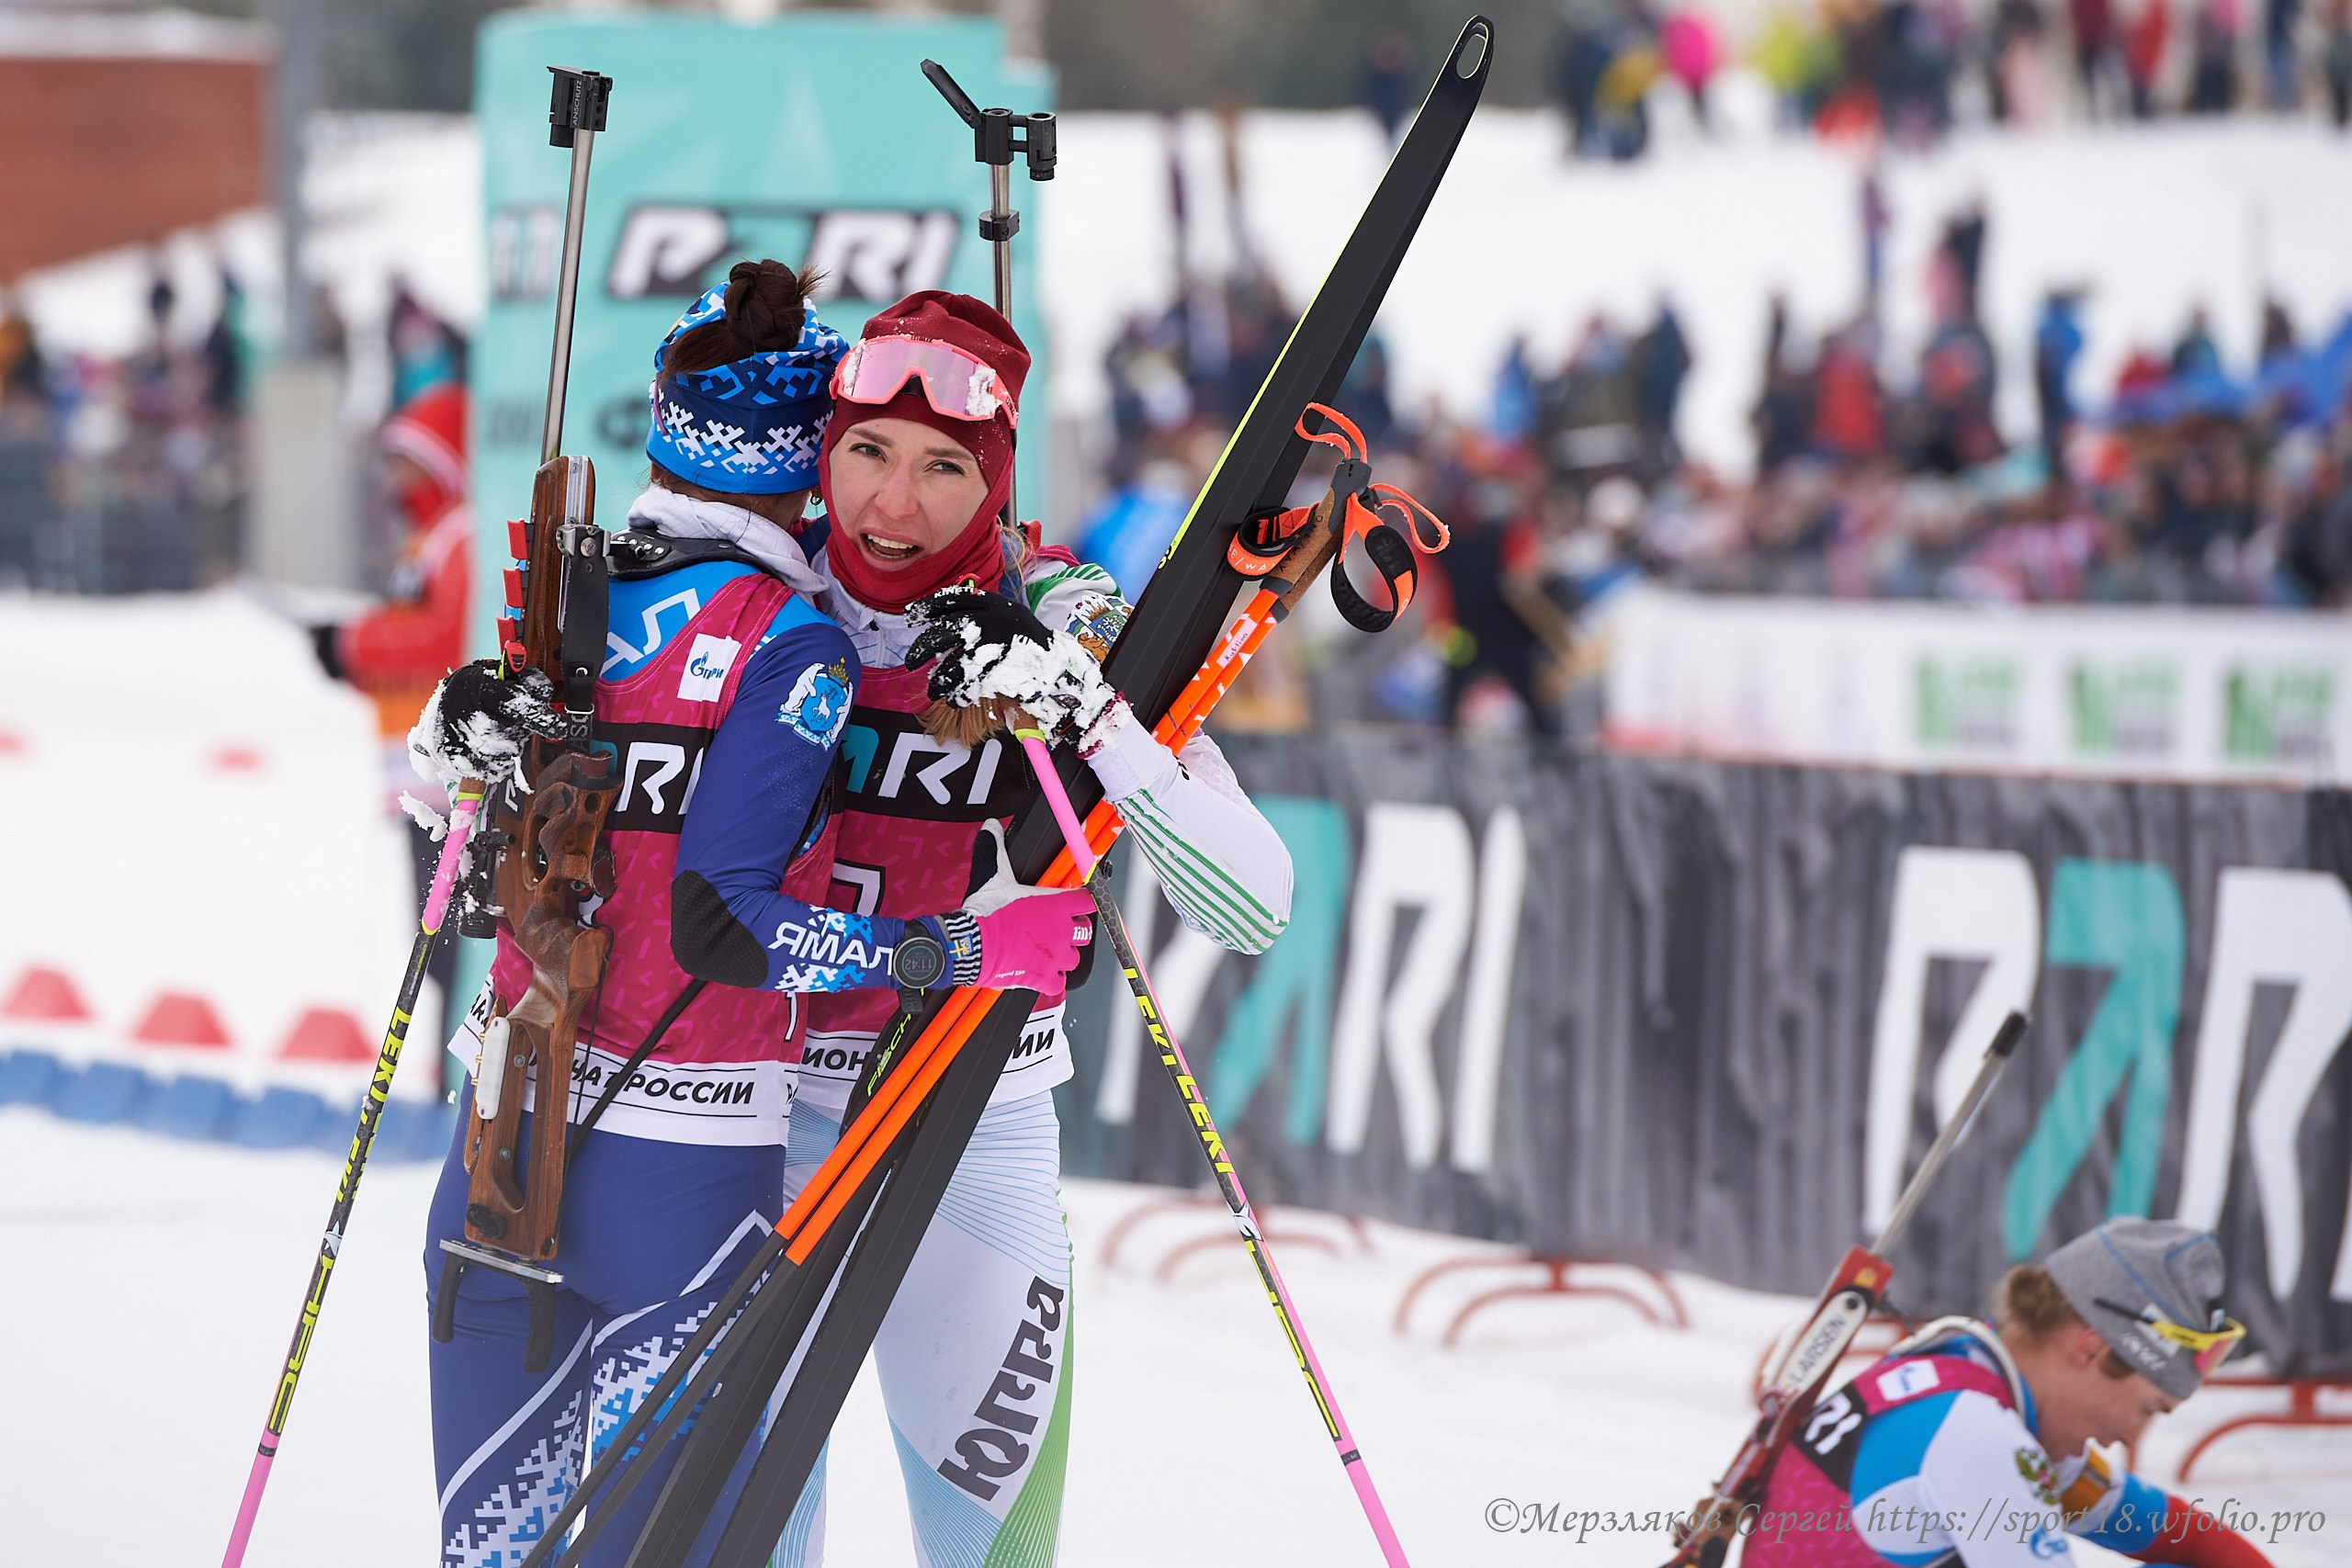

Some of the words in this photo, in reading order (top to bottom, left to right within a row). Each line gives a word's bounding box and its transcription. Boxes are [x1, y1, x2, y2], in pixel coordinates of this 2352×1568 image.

[768, 921, 894, 976] ЯМАЛ
[371, 1008, 411, 1102] LEKI
[623, 1073, 755, 1105] РОССИИ
[866, 1013, 911, 1097] FISCH
[1862, 845, 2352, 1302] PAR
[1176, 1075, 1233, 1173] LEKI
